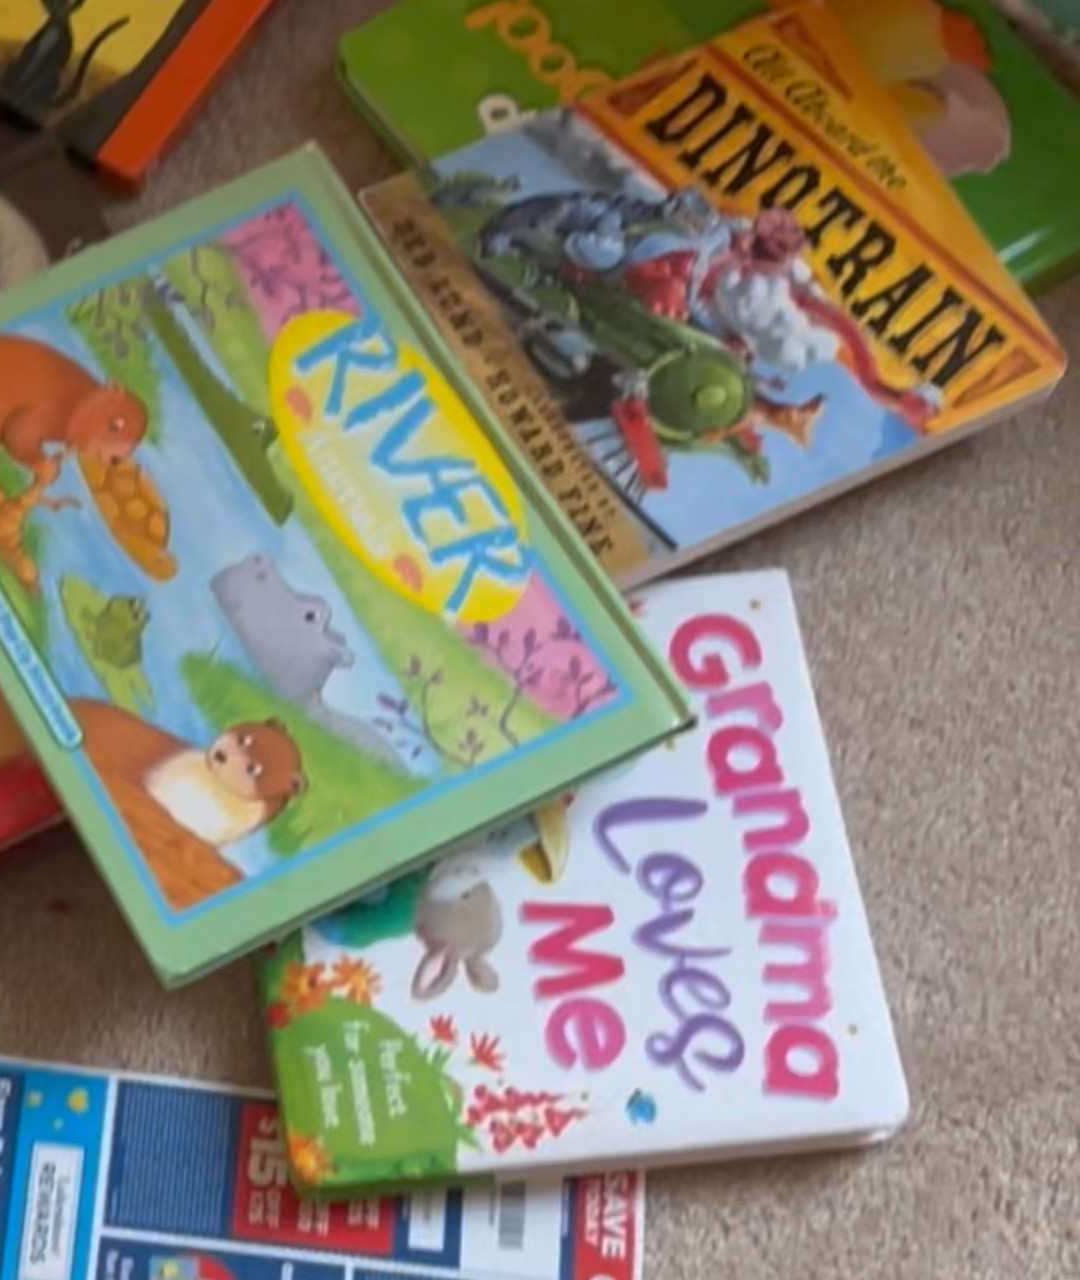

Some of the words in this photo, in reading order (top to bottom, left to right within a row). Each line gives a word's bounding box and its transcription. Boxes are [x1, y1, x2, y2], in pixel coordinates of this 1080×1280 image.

[644, 70, 1008, 392] DINOTRAIN
[291, 306, 531, 616] RIVER
[520, 900, 626, 1072] Me
[592, 796, 746, 1091] Loves
[668, 612, 840, 1101] Grandma
[601, 1171, 628, 1260] SAVE
